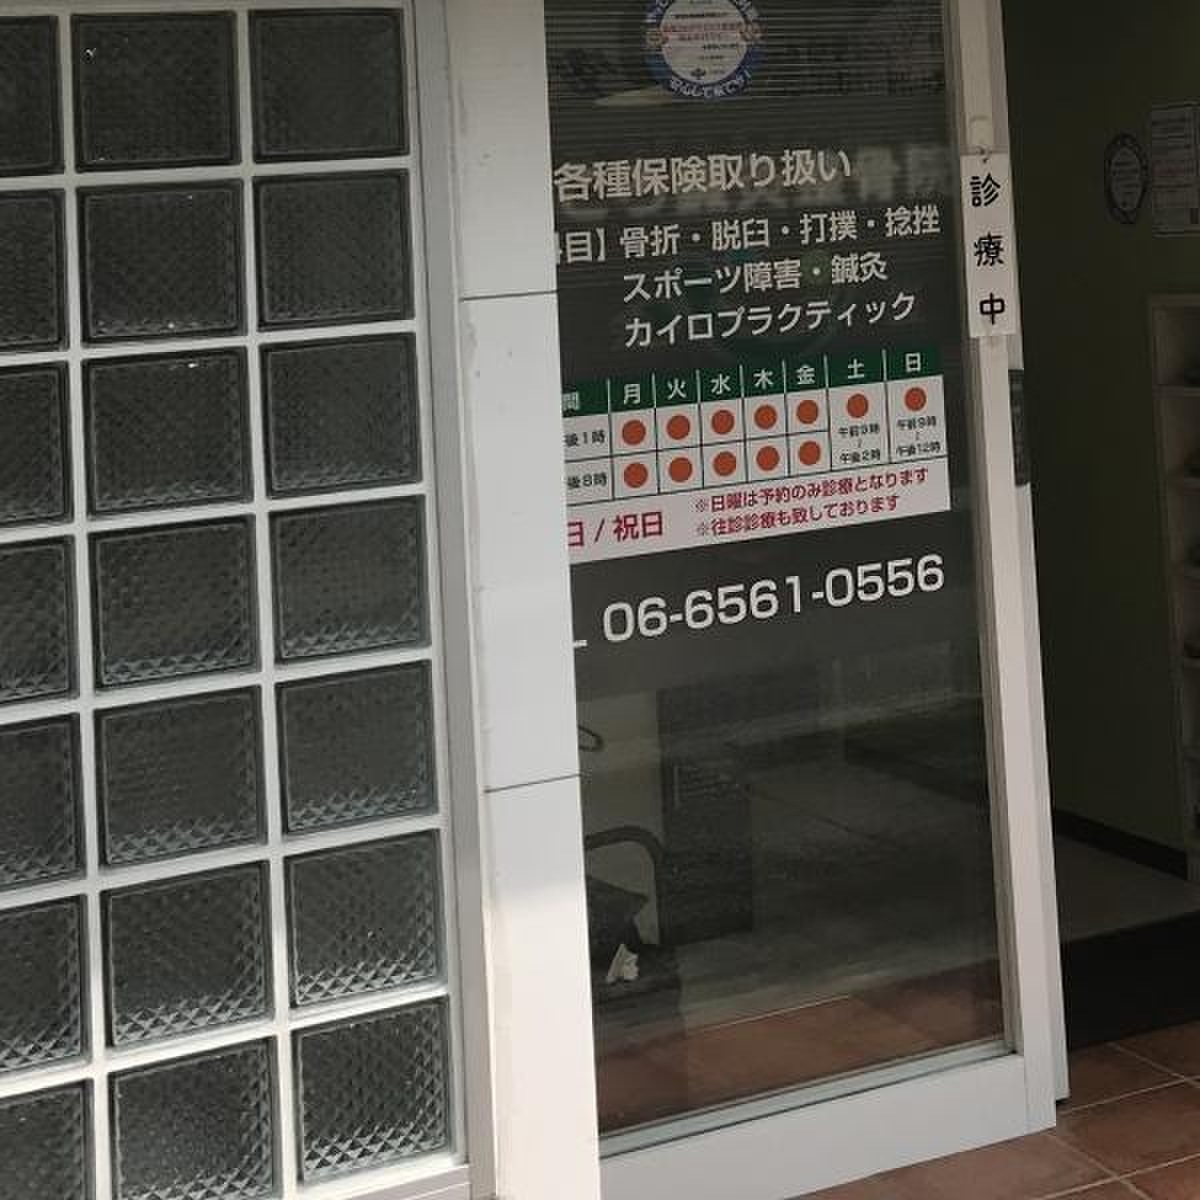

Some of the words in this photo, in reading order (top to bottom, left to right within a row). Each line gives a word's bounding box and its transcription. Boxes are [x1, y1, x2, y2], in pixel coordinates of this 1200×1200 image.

[554, 149, 851, 202] 各種保険取り扱い
[970, 172, 1006, 326] 診療中
[622, 251, 888, 303] スポーツ障害・鍼灸
[624, 291, 915, 348] カイロプラクティック
[623, 383, 641, 405] 月
[667, 378, 687, 400] 火
[710, 373, 732, 395] 水
[753, 368, 773, 389] 木
[795, 364, 816, 385] 金
[847, 358, 865, 379] 土
[905, 352, 922, 373] 日
[603, 554, 945, 642] 06-6561-0556
